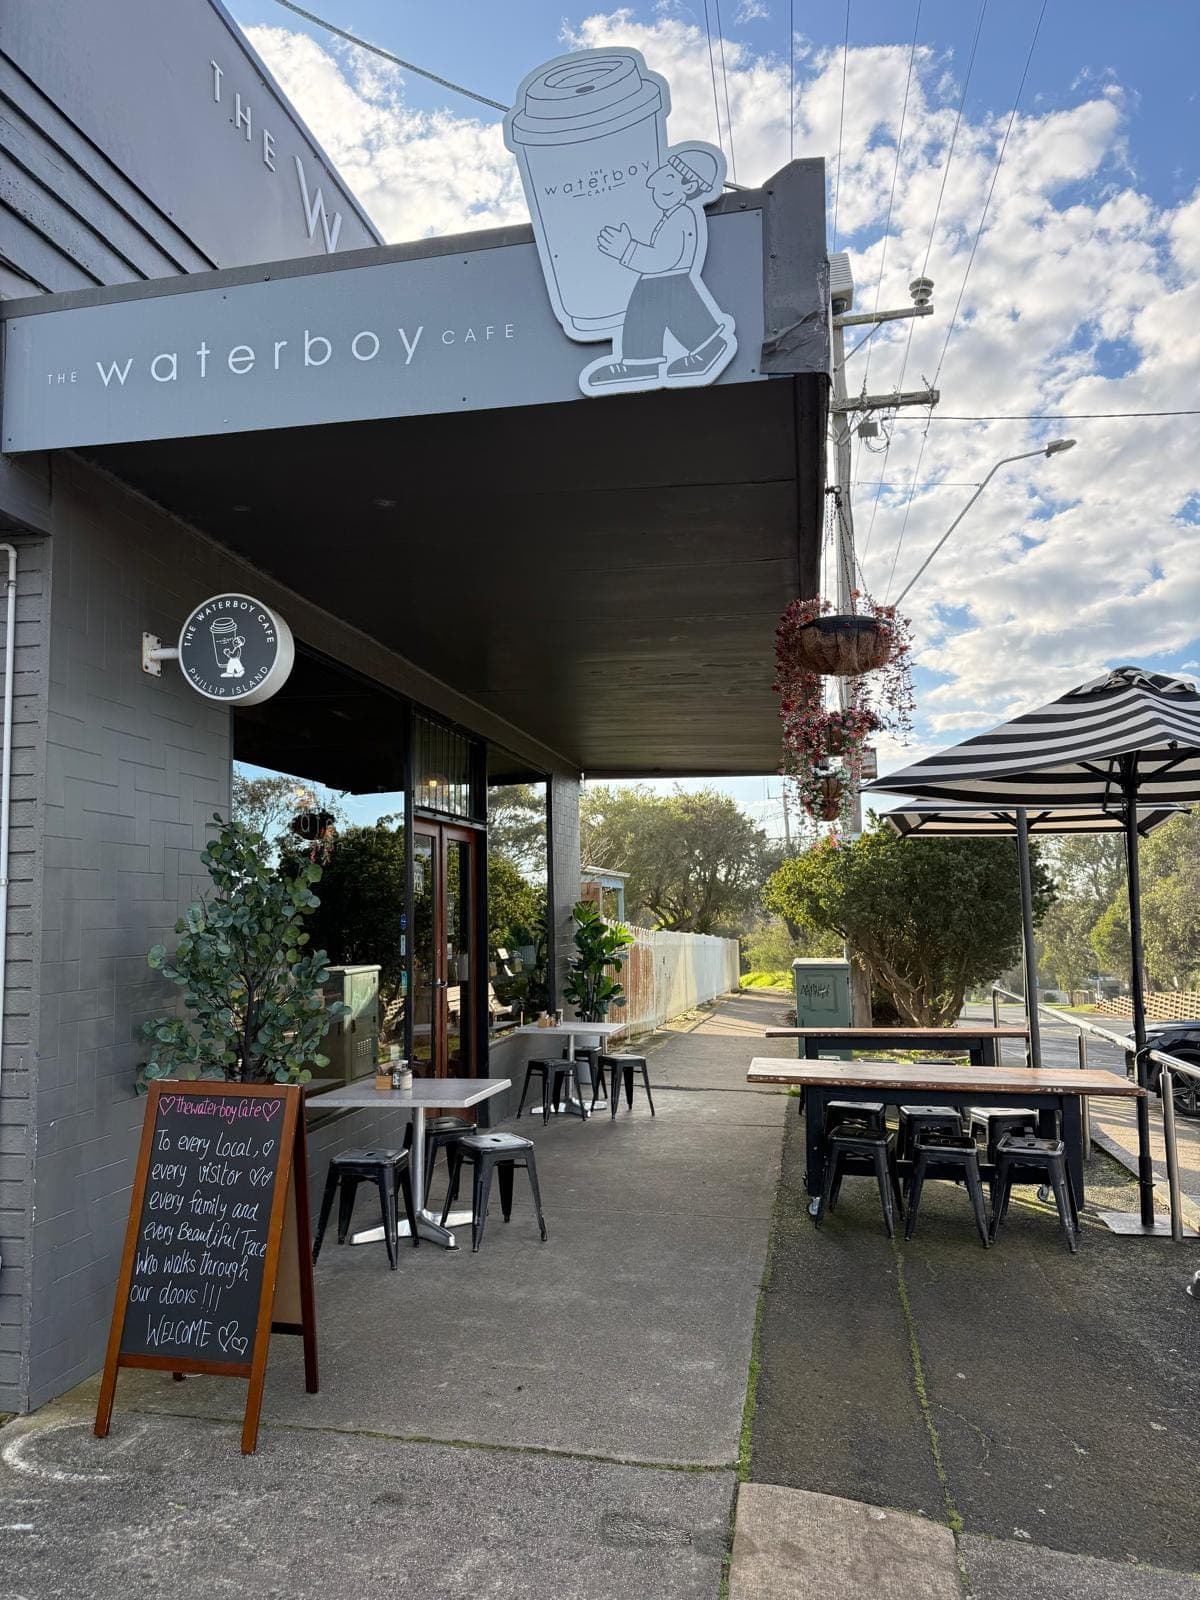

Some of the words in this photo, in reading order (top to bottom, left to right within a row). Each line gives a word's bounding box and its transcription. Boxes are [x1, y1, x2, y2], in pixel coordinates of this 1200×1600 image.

[210, 59, 276, 173] THE
[544, 160, 650, 196] waterboy
[47, 371, 79, 385] THE
[96, 325, 424, 387] waterboy
[441, 323, 515, 345] CAFE
[183, 625, 197, 647] THE
[196, 600, 256, 622] WATERBOY
[257, 614, 275, 643] CAFE
[188, 667, 226, 696] PHILLIP
[231, 666, 269, 696] ISLAND
[157, 1129, 171, 1151] To
[177, 1135, 210, 1160] every
[151, 1163, 187, 1188] every
[198, 1161, 243, 1186] visitor
[149, 1191, 185, 1215] every
[188, 1189, 228, 1222] family
[231, 1203, 259, 1222] and
[177, 1221, 241, 1250] Beautiful
[241, 1229, 268, 1258] Face
[163, 1249, 197, 1274] walks
[199, 1250, 249, 1289] through
[130, 1284, 154, 1302] our
[146, 1313, 214, 1348] WELCOME
